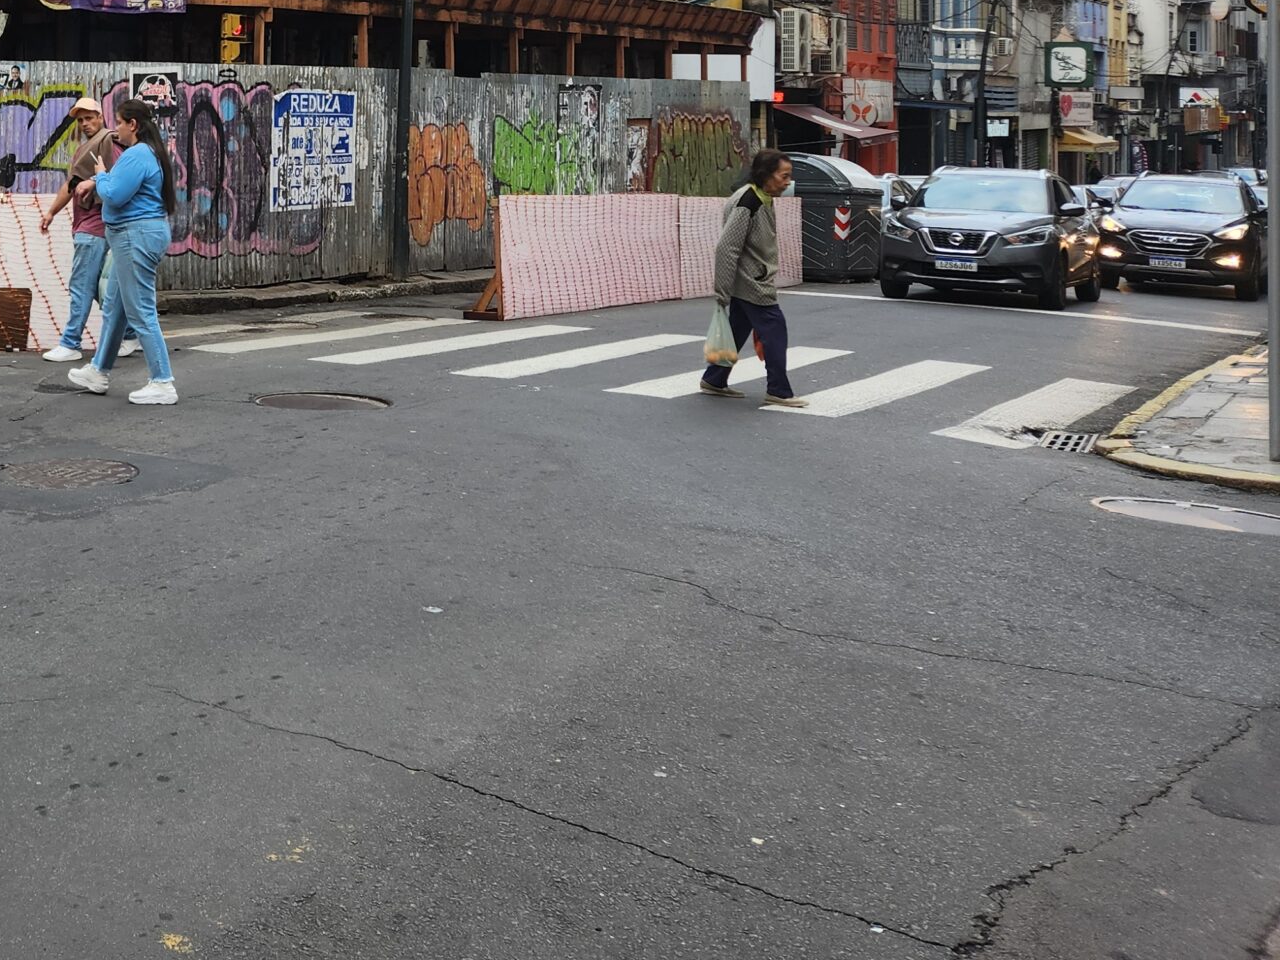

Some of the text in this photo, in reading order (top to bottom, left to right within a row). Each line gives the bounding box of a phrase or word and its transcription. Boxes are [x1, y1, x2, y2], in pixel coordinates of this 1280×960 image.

[290, 94, 341, 113] REDUZA
[304, 117, 313, 126] DO
[329, 116, 351, 127] CARRO
